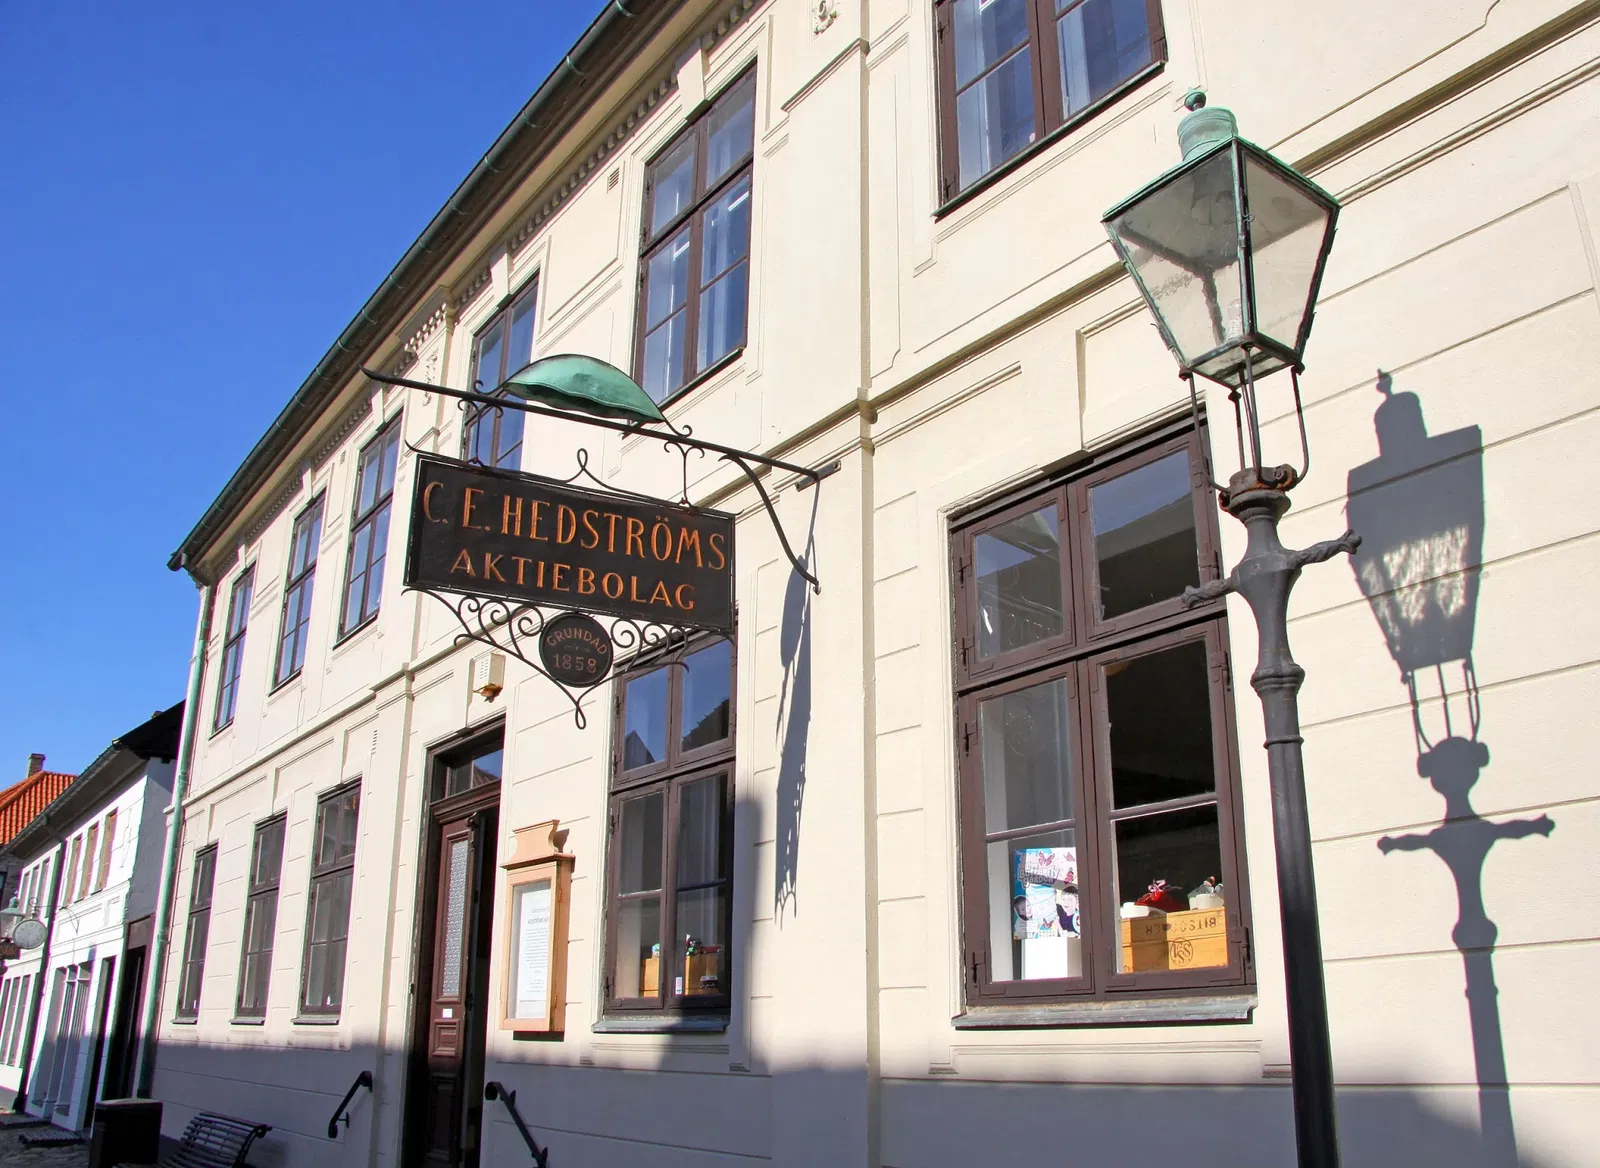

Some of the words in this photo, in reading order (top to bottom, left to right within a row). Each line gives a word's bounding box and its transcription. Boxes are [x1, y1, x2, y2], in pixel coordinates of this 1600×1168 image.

[423, 480, 449, 525] C.
[461, 487, 491, 533] E.
[501, 494, 727, 571] HEDSTRÖMS
[449, 548, 696, 611] AKTIEBOLAG
[546, 627, 608, 655] GRUNDAD
[553, 653, 597, 674] 1858
